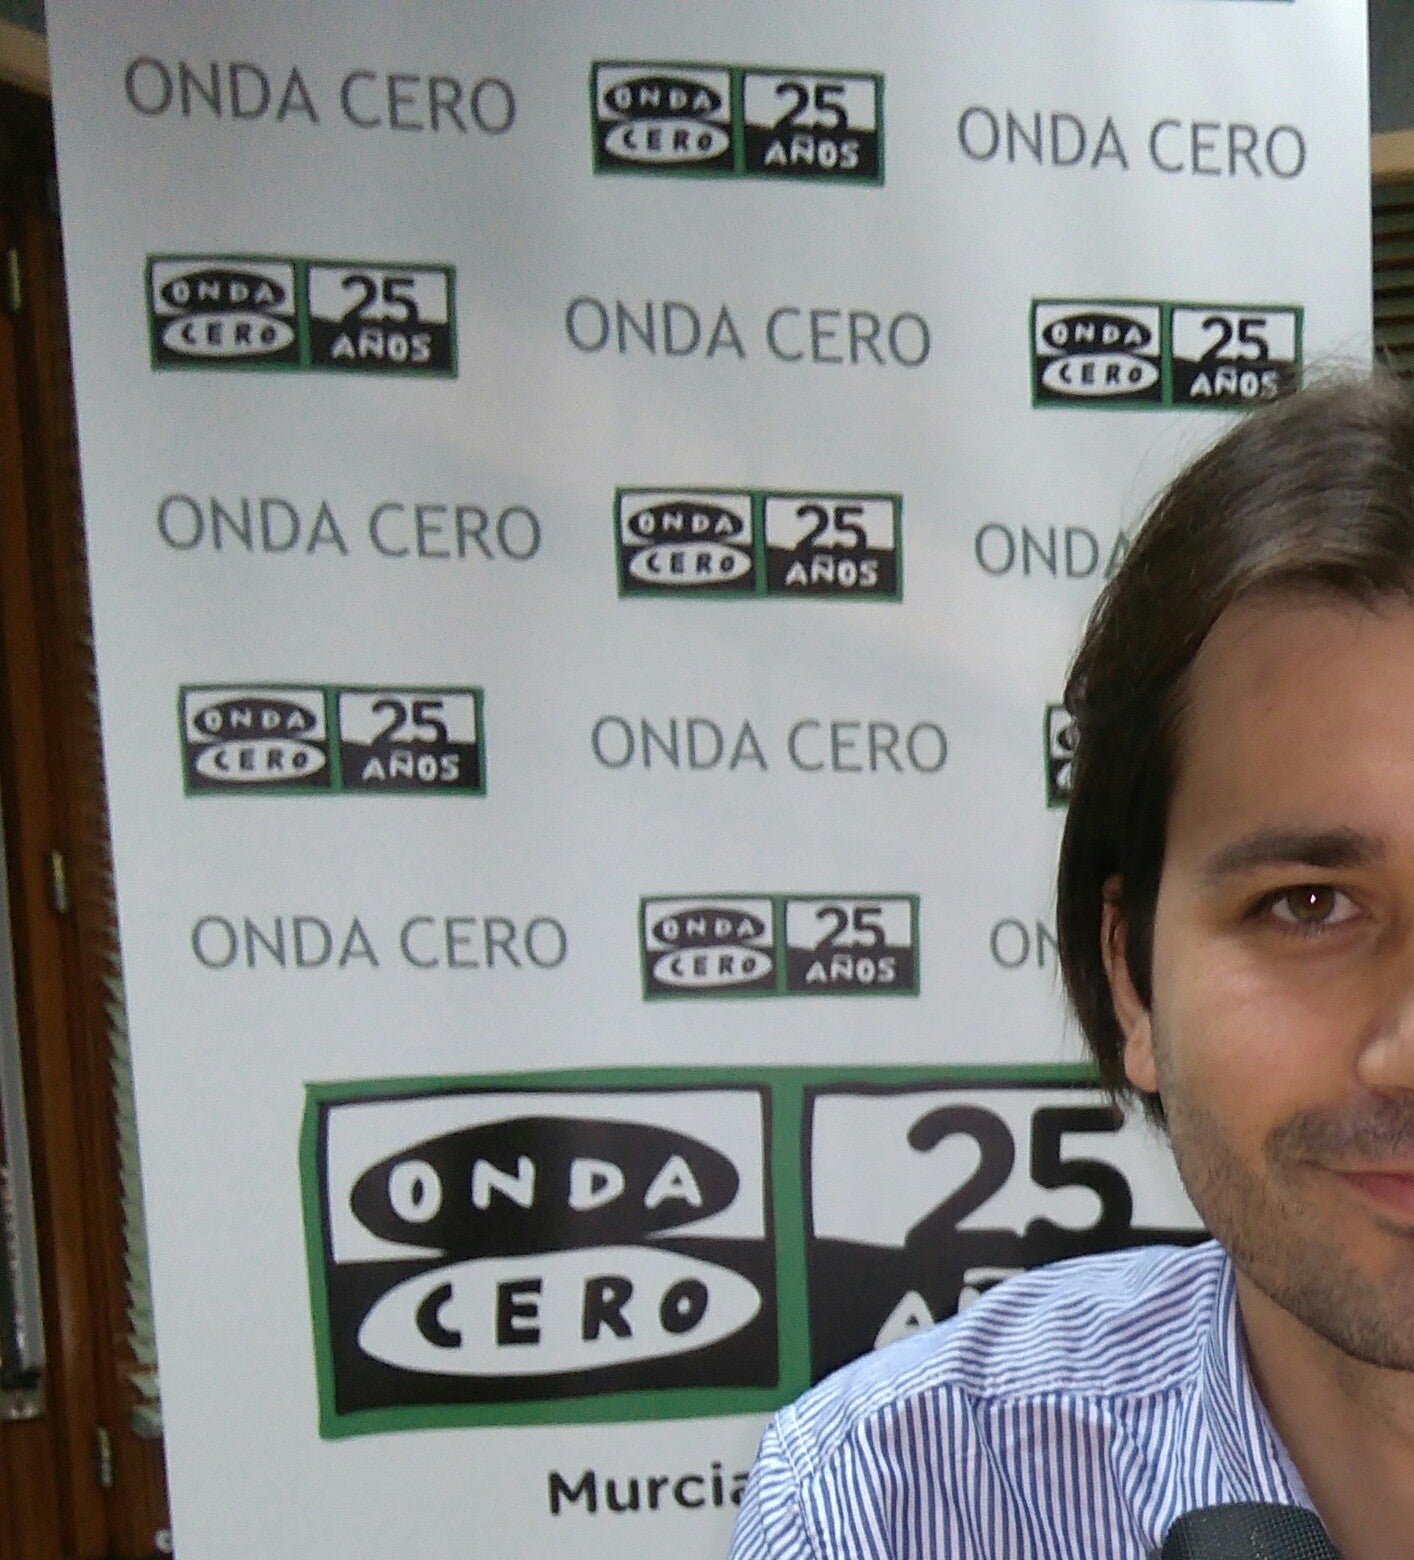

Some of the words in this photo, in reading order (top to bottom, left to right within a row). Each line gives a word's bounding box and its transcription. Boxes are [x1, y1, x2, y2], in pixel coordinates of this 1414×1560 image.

[124, 56, 320, 124] ONDA
[340, 68, 517, 136] CERO
[613, 85, 713, 112] ONDA
[775, 81, 849, 131] 25
[623, 127, 712, 151] CERO
[763, 133, 860, 169] AÑOS
[957, 106, 1128, 171] ONDA
[1148, 119, 1307, 179] CERO
[171, 280, 275, 305] ONDA
[341, 275, 418, 324] 25
[181, 322, 277, 346] CERO
[330, 325, 433, 363] AÑOS
[565, 296, 745, 360] ONDA
[767, 307, 931, 368] CERO
[1051, 321, 1143, 347] ONDA
[1201, 316, 1269, 362] 25
[1058, 362, 1142, 385] CERO
[1189, 365, 1280, 398] AÑOS
[156, 494, 348, 556] ONDA
[368, 502, 542, 562] CERO
[638, 511, 733, 535] ONDA
[796, 504, 867, 551] 25
[646, 551, 735, 574] CERO
[785, 554, 879, 587] AÑOS
[203, 707, 305, 733] ONDA
[372, 700, 448, 748] 25
[214, 748, 308, 771] CERO
[590, 714, 768, 772] ONDA
[787, 720, 949, 774] CERO
[361, 750, 460, 782] AÑOS
[190, 914, 380, 970] ONDA
[400, 914, 569, 970] CERO
[662, 917, 755, 941] ONDA
[815, 907, 885, 953] 25
[670, 954, 756, 977] CERO
[805, 953, 896, 984] AÑOS
[386, 1156, 705, 1226] ONDA
[904, 1104, 1135, 1245] 25
[415, 1276, 711, 1350] CERO
